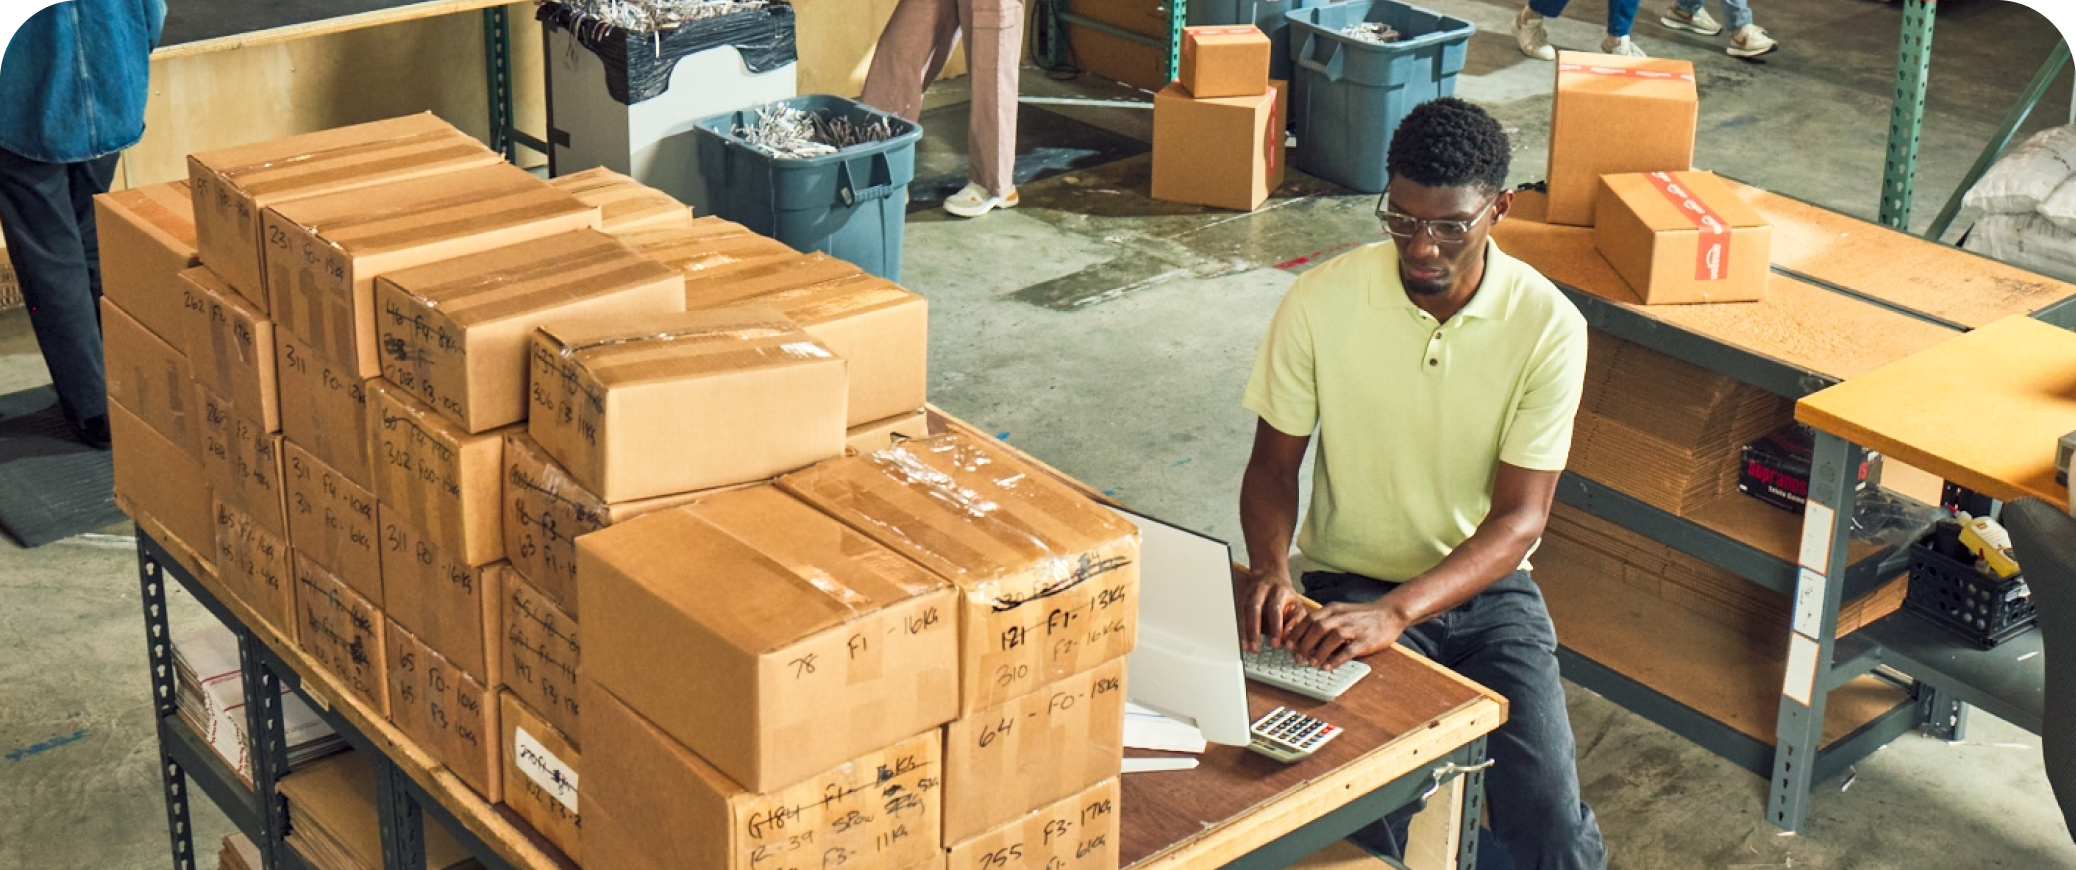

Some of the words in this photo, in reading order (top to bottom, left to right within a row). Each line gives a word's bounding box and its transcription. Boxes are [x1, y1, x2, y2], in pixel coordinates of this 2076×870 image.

[184, 291, 205, 313] 262
[285, 344, 306, 375] 311
[386, 523, 407, 553] 311
[1001, 625, 1026, 652] 121
[788, 652, 819, 680] 78
[847, 632, 868, 660] F1
[996, 664, 1029, 688] 310
[978, 717, 1015, 749] 64
